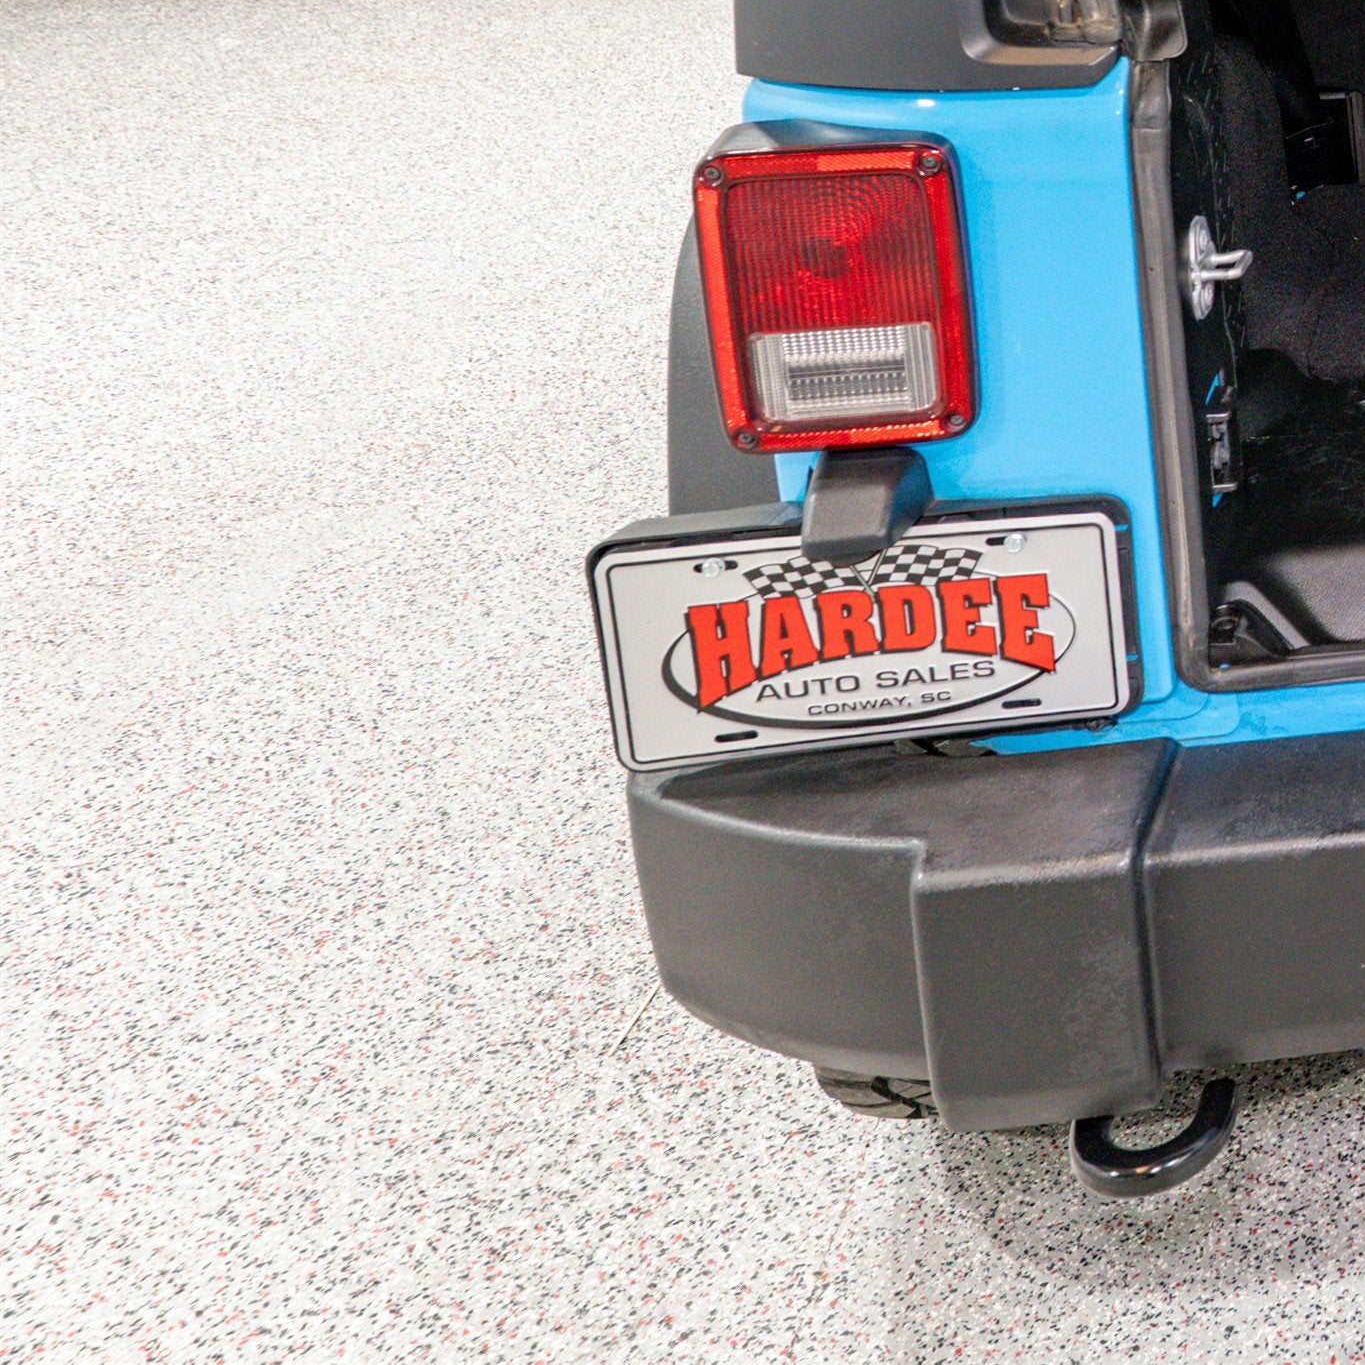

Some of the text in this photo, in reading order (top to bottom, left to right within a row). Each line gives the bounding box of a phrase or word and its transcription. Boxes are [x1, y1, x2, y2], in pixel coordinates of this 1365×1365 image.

[685, 572, 1057, 712] HARDEE
[755, 659, 996, 703] AUTO SALES
[806, 690, 952, 717] CONWAY, SC
